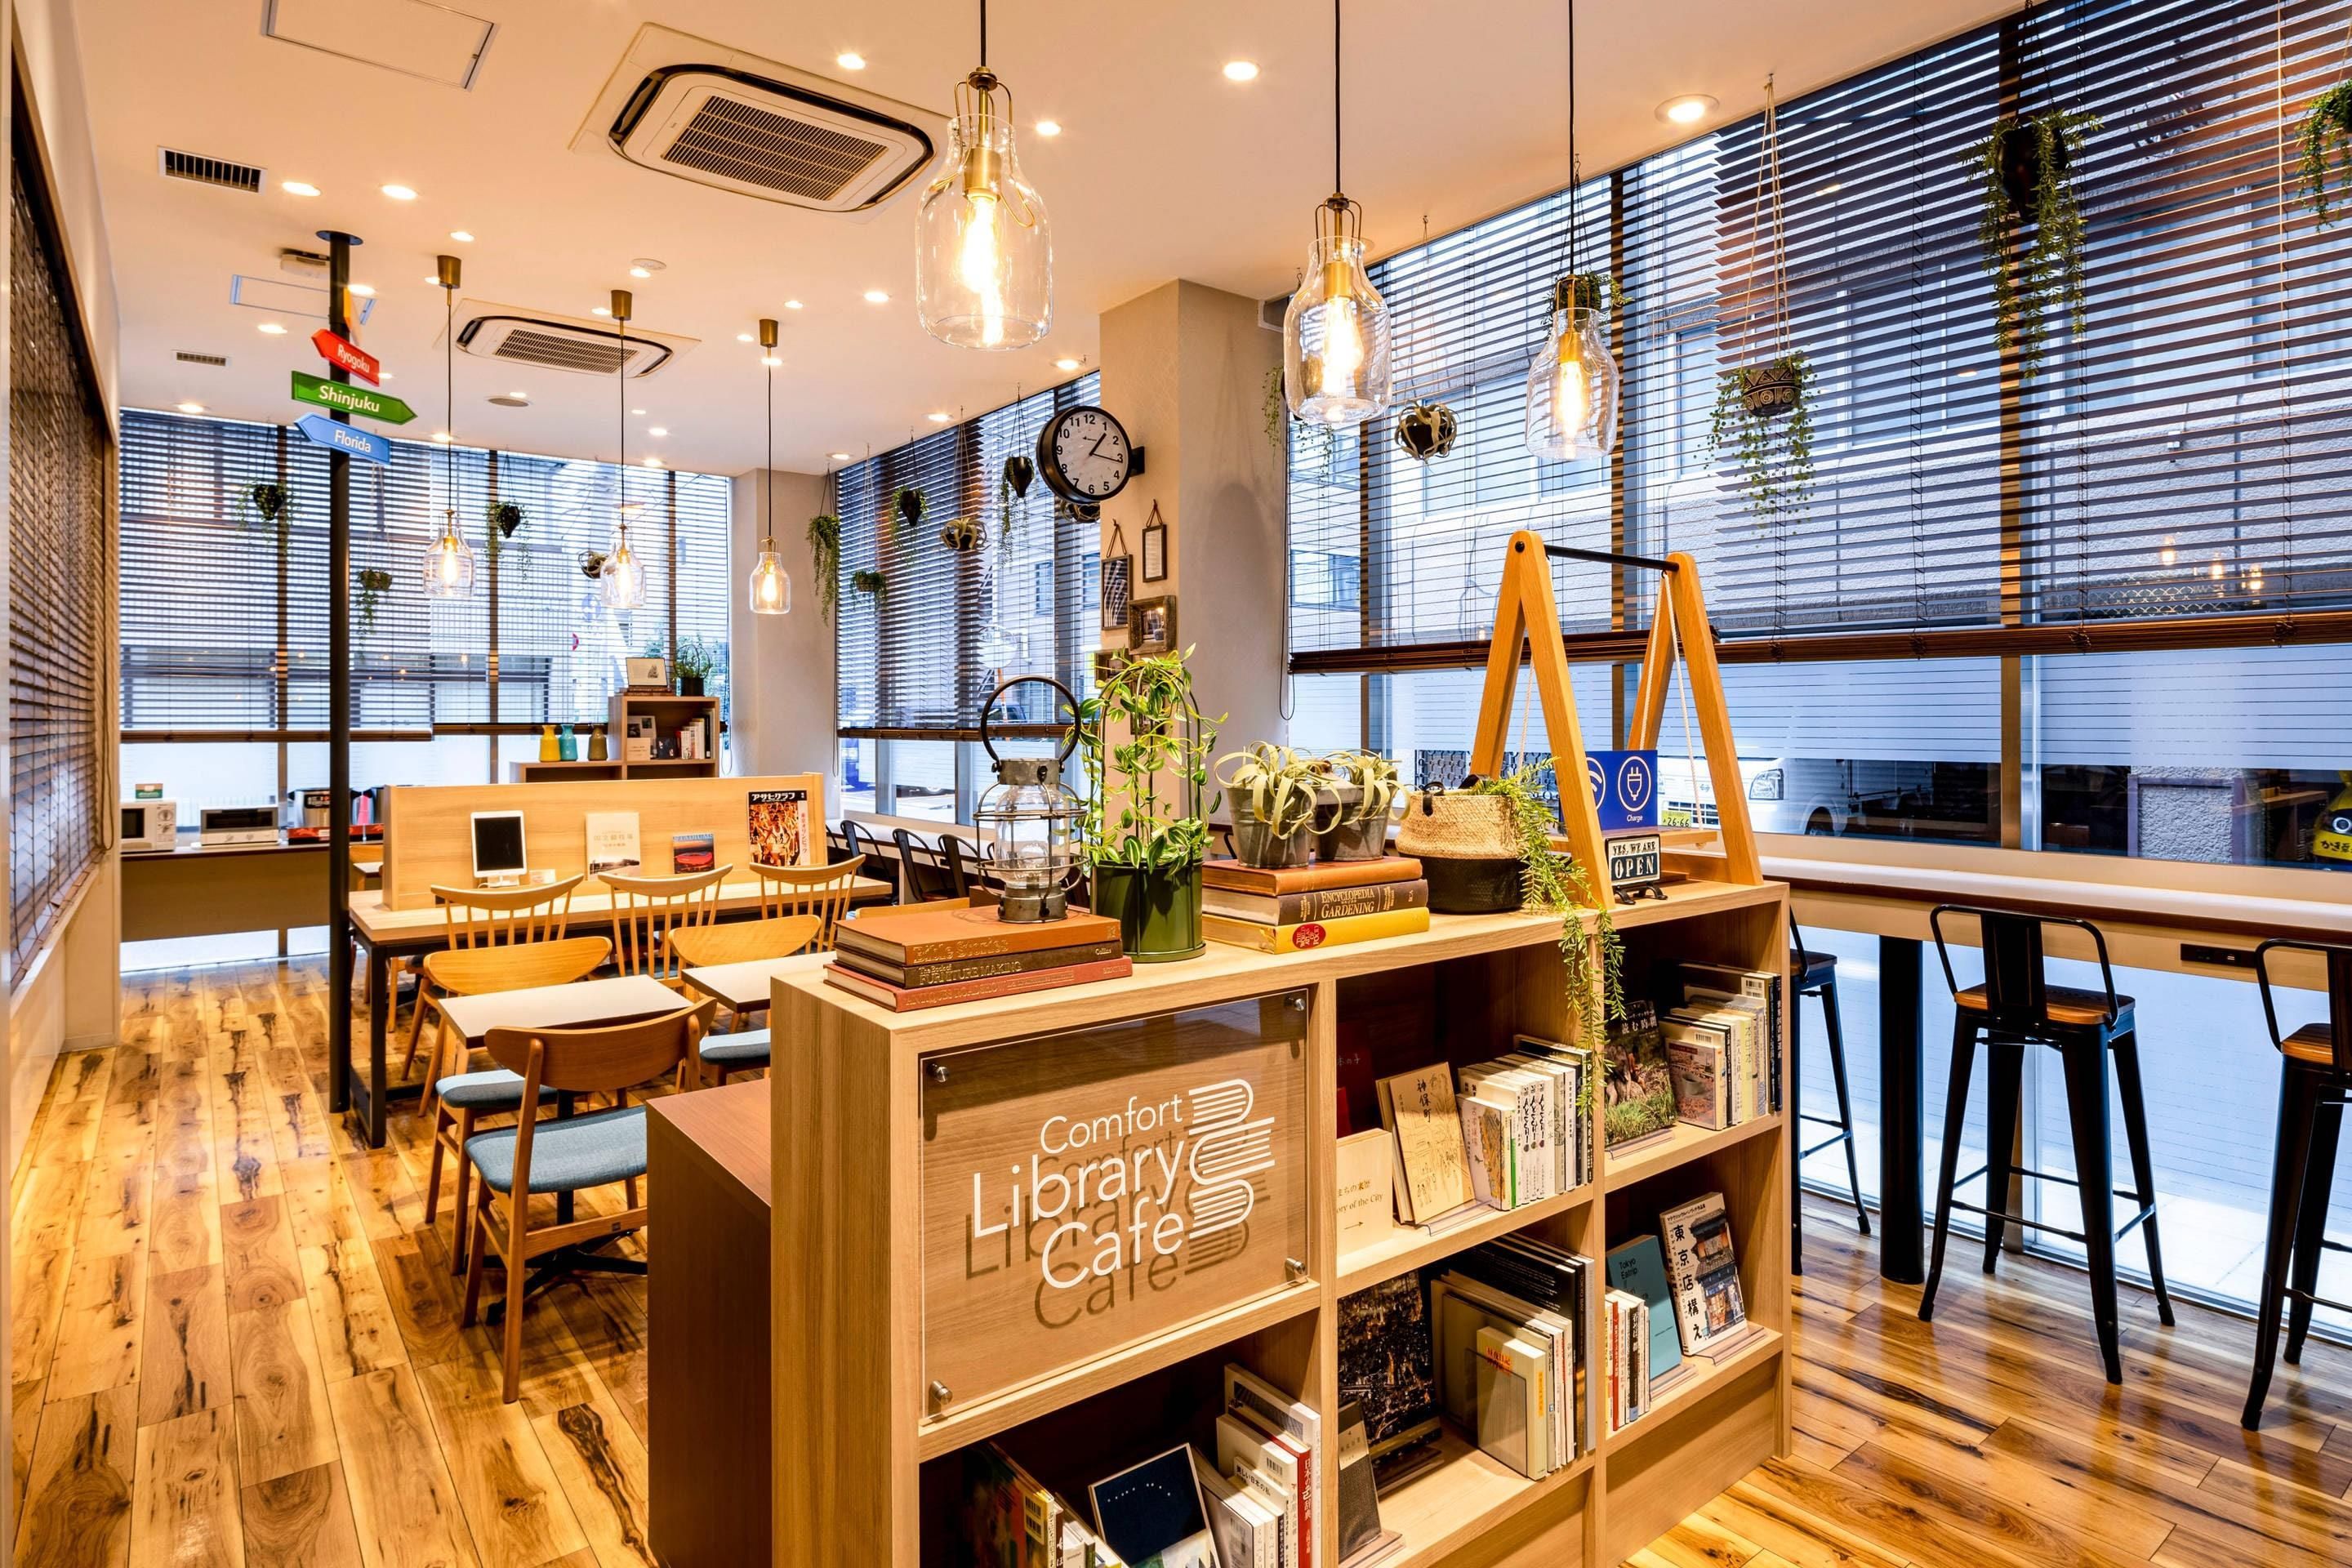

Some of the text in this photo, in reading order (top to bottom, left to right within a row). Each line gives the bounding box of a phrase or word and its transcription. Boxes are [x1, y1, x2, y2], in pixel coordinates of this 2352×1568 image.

[337, 345, 370, 373] Ryogoku
[318, 385, 380, 412] Shinjuku
[1069, 416, 1080, 427] 11
[1084, 414, 1095, 425] 12
[1102, 421, 1107, 431] 1
[1058, 428, 1070, 439] 10
[1112, 435, 1119, 445] 2
[334, 430, 372, 453] Florida
[1056, 445, 1063, 455] 9
[1116, 453, 1123, 463] 3
[1061, 464, 1067, 474] 8
[1114, 470, 1120, 479] 4
[1073, 478, 1079, 488] 7
[1089, 484, 1094, 494] 6
[1103, 481, 1110, 491] 5
[1627, 814, 1643, 822] Charge
[1613, 841, 1656, 856] YES, WE ARE
[1615, 855, 1655, 879] OPEN
[1321, 888, 1375, 903] ENCYCLOPEDIA
[1321, 902, 1375, 919] GARDENING
[920, 961, 1022, 985] FURNITURE MAKING
[1417, 1079, 1432, 1123] 神保町
[1040, 1094, 1183, 1154] Comfort
[973, 1140, 1184, 1239] Library
[1349, 1200, 1357, 1209] of
[1358, 1198, 1369, 1207] the
[1370, 1193, 1383, 1203] City
[1042, 1196, 1184, 1289] Cafe
[1619, 1258, 1637, 1271] Tokyo
[1674, 1225, 1703, 1340] 東京店構え
[1303, 1458, 1312, 1521] 日本の色辞典
